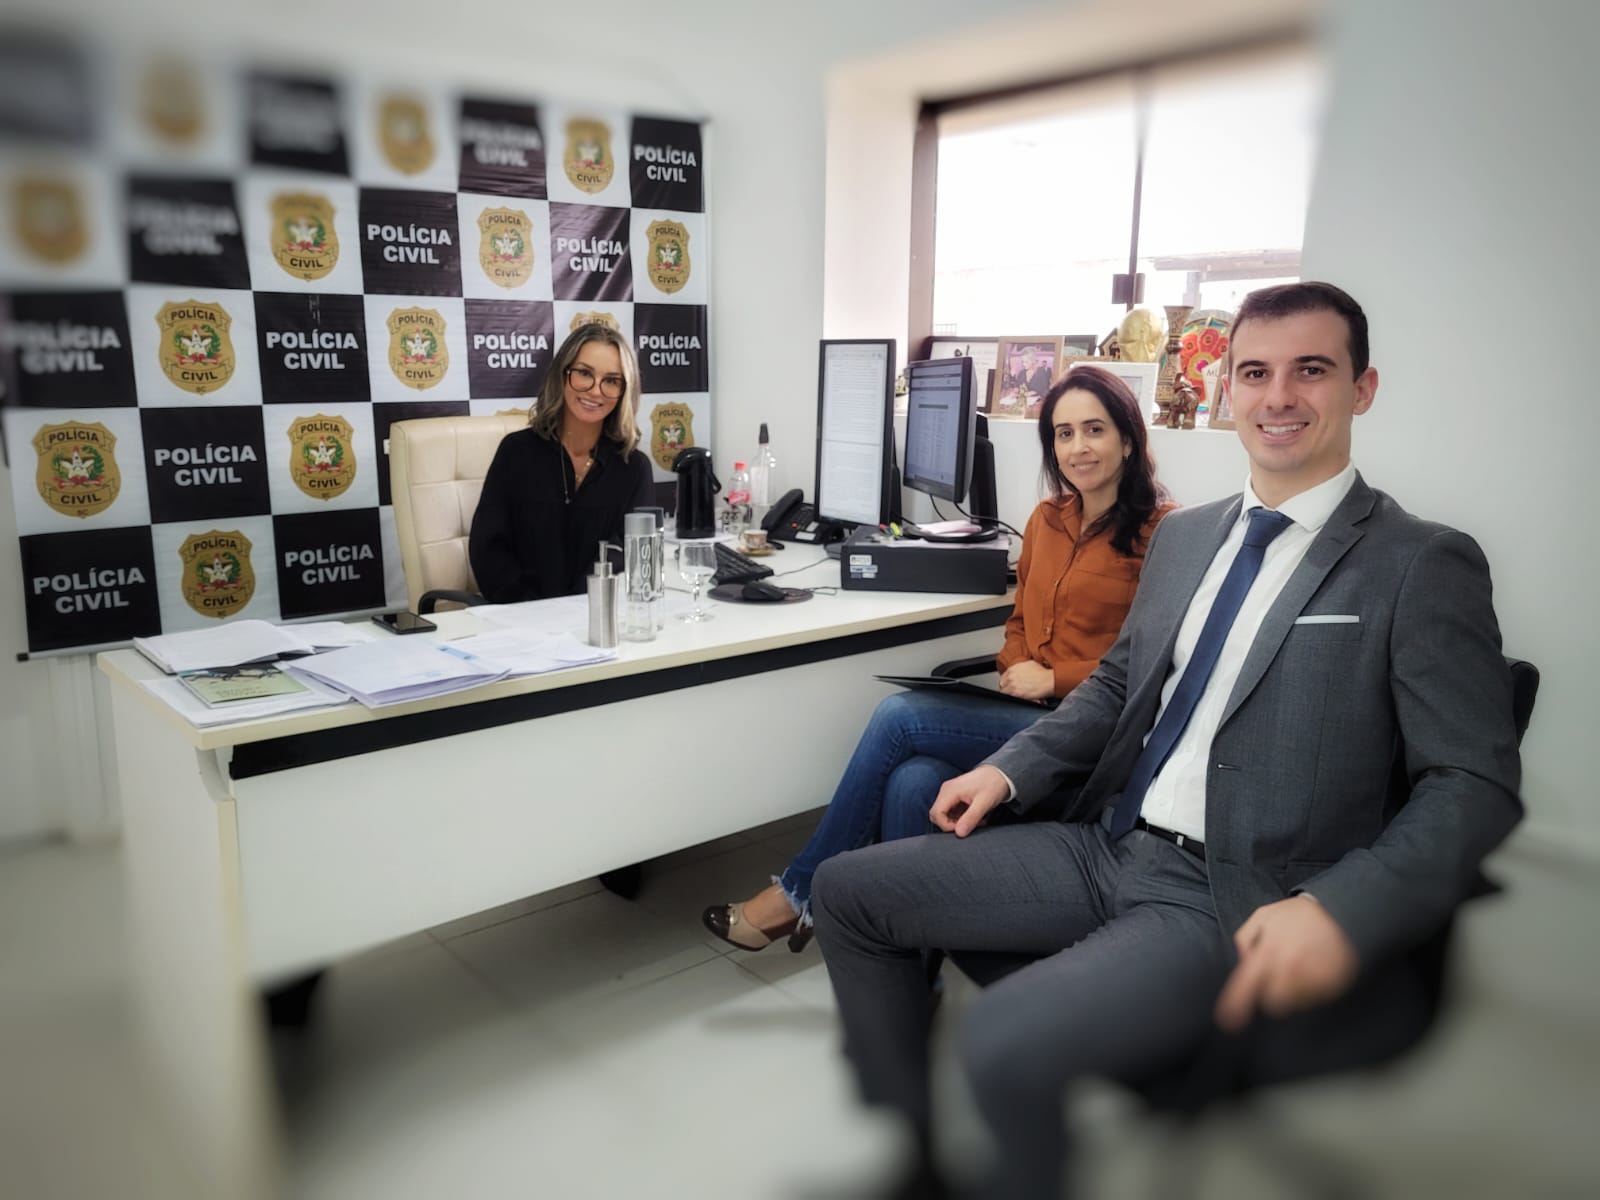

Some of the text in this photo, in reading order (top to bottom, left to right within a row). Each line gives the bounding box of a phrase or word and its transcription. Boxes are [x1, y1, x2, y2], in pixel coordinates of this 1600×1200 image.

[634, 143, 697, 168] POLÍCIA
[576, 173, 602, 184] CIVIL
[646, 165, 688, 184] CIVIL
[487, 214, 522, 226] POLÍCIA
[366, 223, 452, 247] POLÍCIA
[383, 244, 440, 266] CIVIL
[556, 236, 625, 257] POLÍCIA
[289, 256, 324, 269] CIVIL
[569, 255, 614, 274] CIVIL
[494, 267, 521, 278] CIVIL
[657, 274, 680, 285] CIVIL
[170, 308, 217, 323] POLÍCIA
[397, 313, 435, 327] POLÍCIA
[266, 329, 359, 351] POLÍCIA
[473, 330, 549, 351] POLÍCIA
[638, 331, 702, 350] POLÍCIA
[283, 351, 346, 372] CIVIL
[487, 351, 537, 370] CIVIL
[650, 348, 690, 367] CIVIL
[180, 369, 219, 382] CIVIL
[405, 369, 436, 380] CIVIL
[658, 408, 685, 418] POLÍCIA
[48, 428, 100, 445] POLÍCIA
[300, 420, 341, 434] POLÍCIA
[154, 443, 258, 467] POLÍCIA
[174, 466, 242, 487] CIVIL
[308, 477, 341, 489] CIVIL
[60, 492, 103, 506] CIVIL
[193, 537, 238, 553] POLÍCIA
[284, 543, 375, 568] POLÍCIA
[33, 566, 147, 596] POLÍCIA
[301, 563, 361, 587] CIVIL
[55, 591, 129, 616] CIVIL
[203, 593, 239, 608] CIVIL
